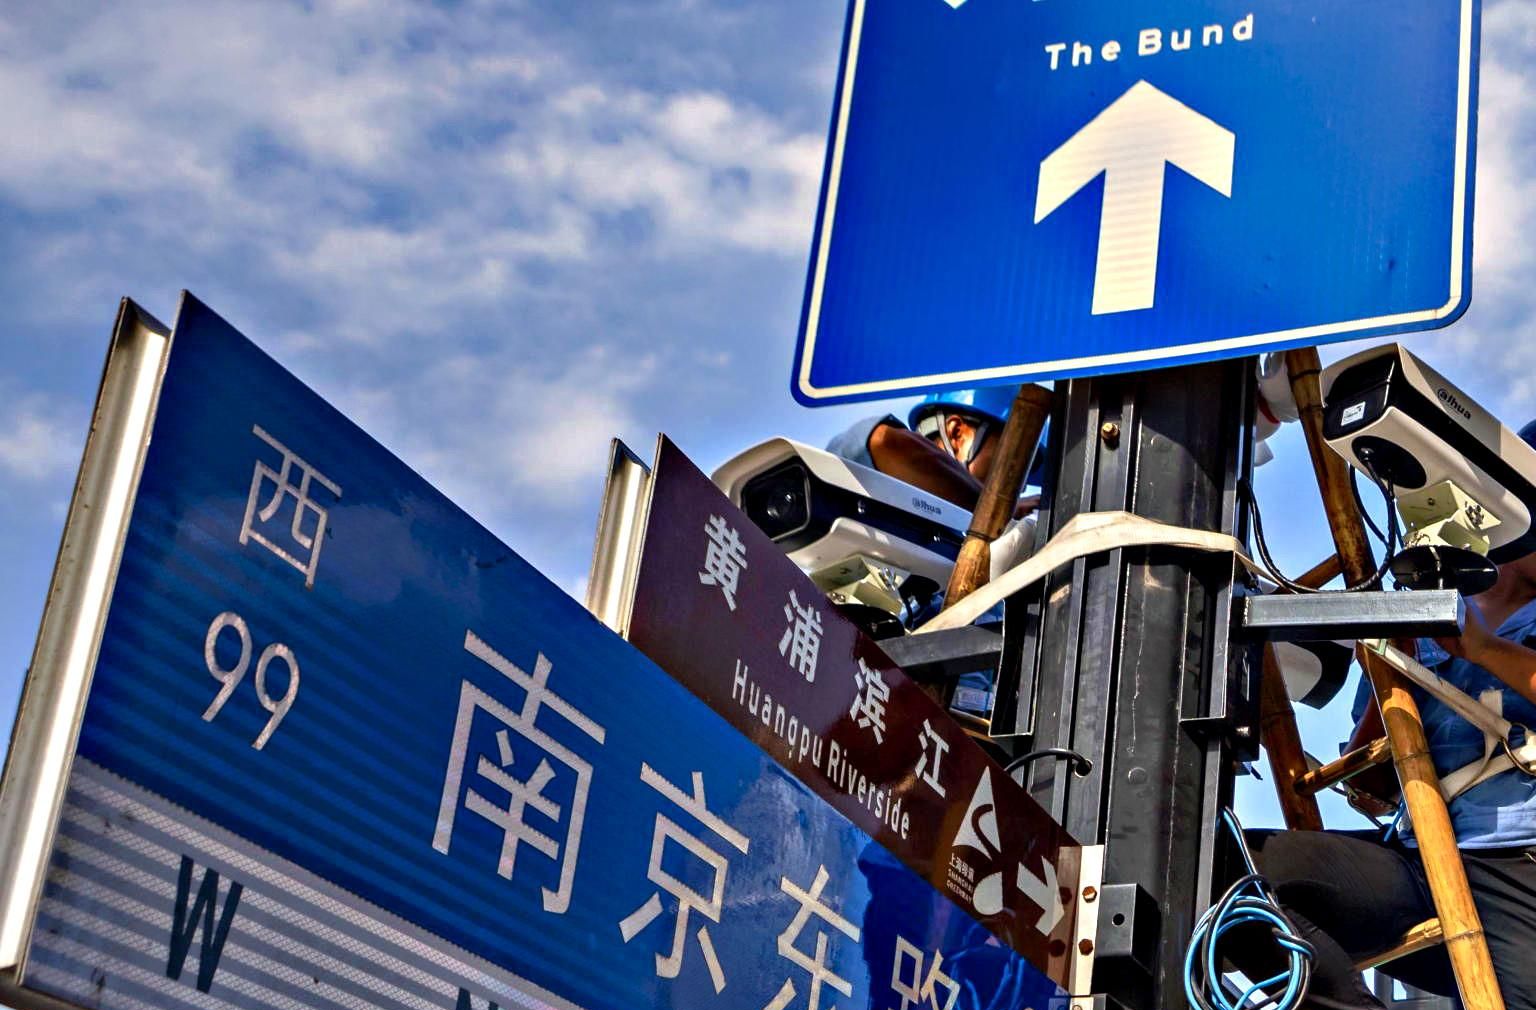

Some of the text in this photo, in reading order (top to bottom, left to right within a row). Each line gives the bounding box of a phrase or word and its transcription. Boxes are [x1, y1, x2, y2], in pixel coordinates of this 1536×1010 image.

[1044, 14, 1255, 71] The Bund
[239, 424, 342, 590] 西
[201, 611, 300, 750] 99
[699, 514, 949, 798] 黄浦滨江
[732, 660, 910, 840] Huangpu Riverside
[167, 854, 242, 992] W
